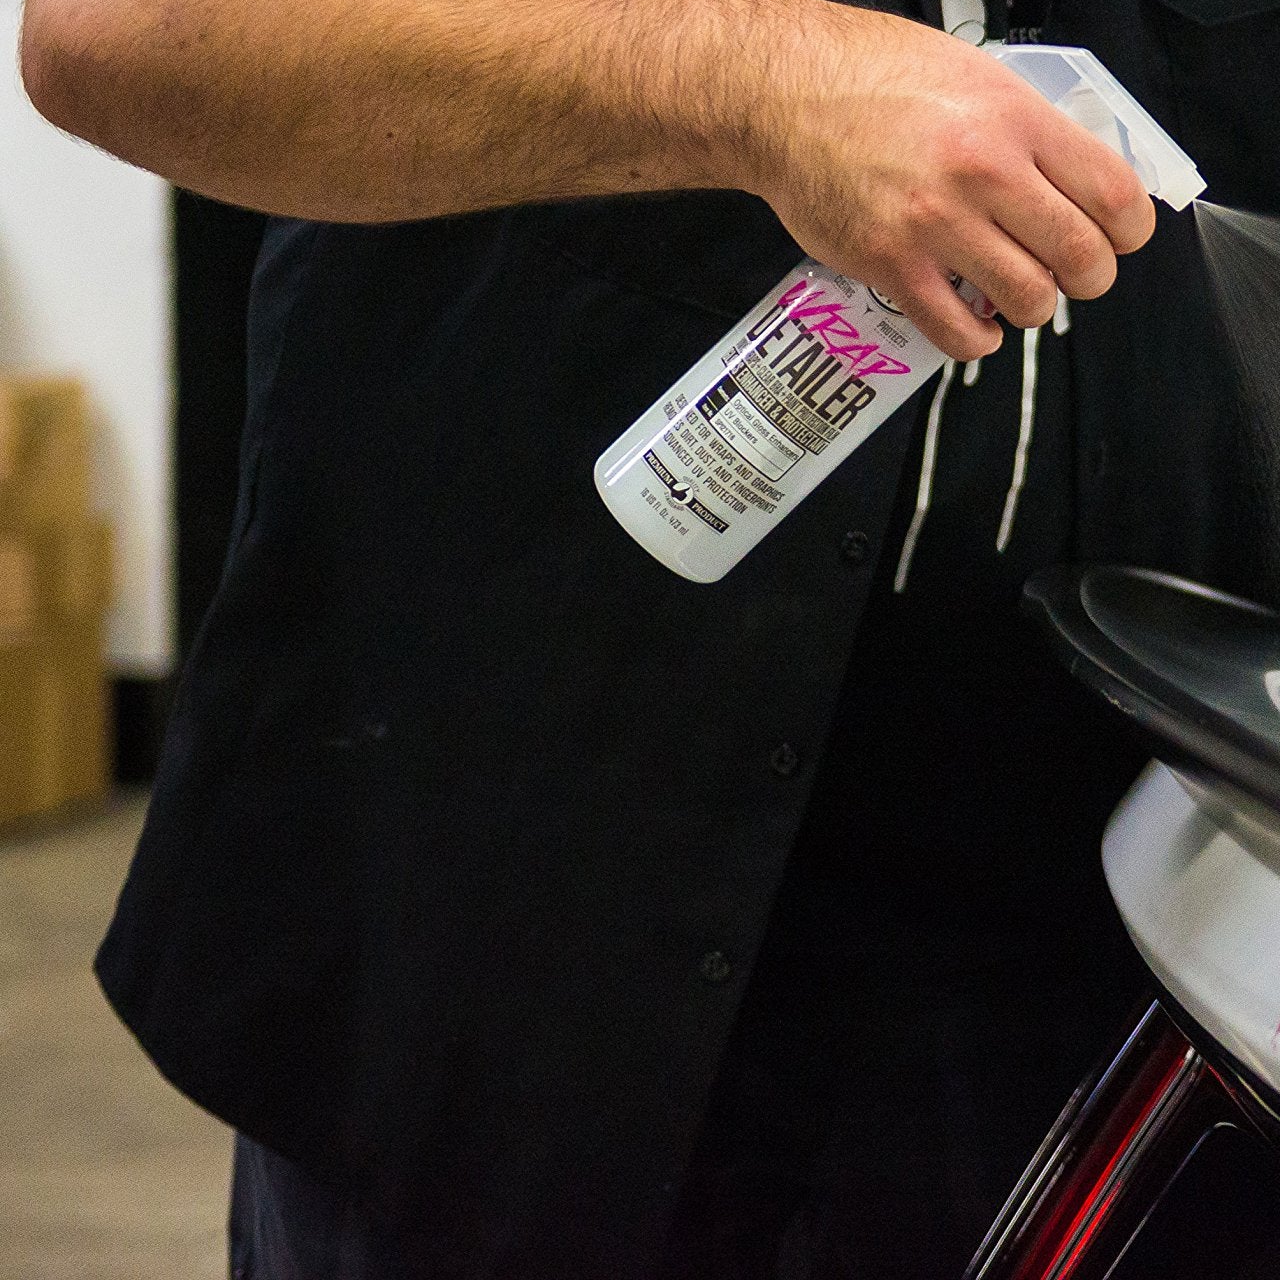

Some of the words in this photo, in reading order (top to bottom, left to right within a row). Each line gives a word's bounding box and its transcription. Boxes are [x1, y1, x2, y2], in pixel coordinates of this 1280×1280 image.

[777, 278, 912, 381] WRAP
[876, 320, 909, 349] PROTECTS
[746, 301, 877, 431] DETAILER
[724, 408, 734, 419] UV
[733, 419, 758, 444] Blockers
[733, 399, 754, 420] Optical
[752, 417, 771, 438] Gloss
[769, 435, 799, 460] Enhancers
[738, 368, 776, 412] ENHANCER
[770, 406, 783, 420] &
[780, 412, 829, 454] PROTECTANT
[646, 452, 674, 485] PREMIUM
[680, 428, 699, 450] DIRT,
[695, 446, 717, 470] DUST,
[713, 465, 733, 483] AND
[730, 480, 778, 514] FINGERPRINTS
[691, 464, 706, 478] UV
[702, 476, 748, 514] PROTECTION
[695, 423, 712, 440] FOR
[709, 438, 737, 466] WRAPS
[735, 463, 753, 480] AND
[751, 477, 786, 502] GRAPHICS
[668, 516, 682, 529] 473
[691, 502, 727, 530] PRODUCT
